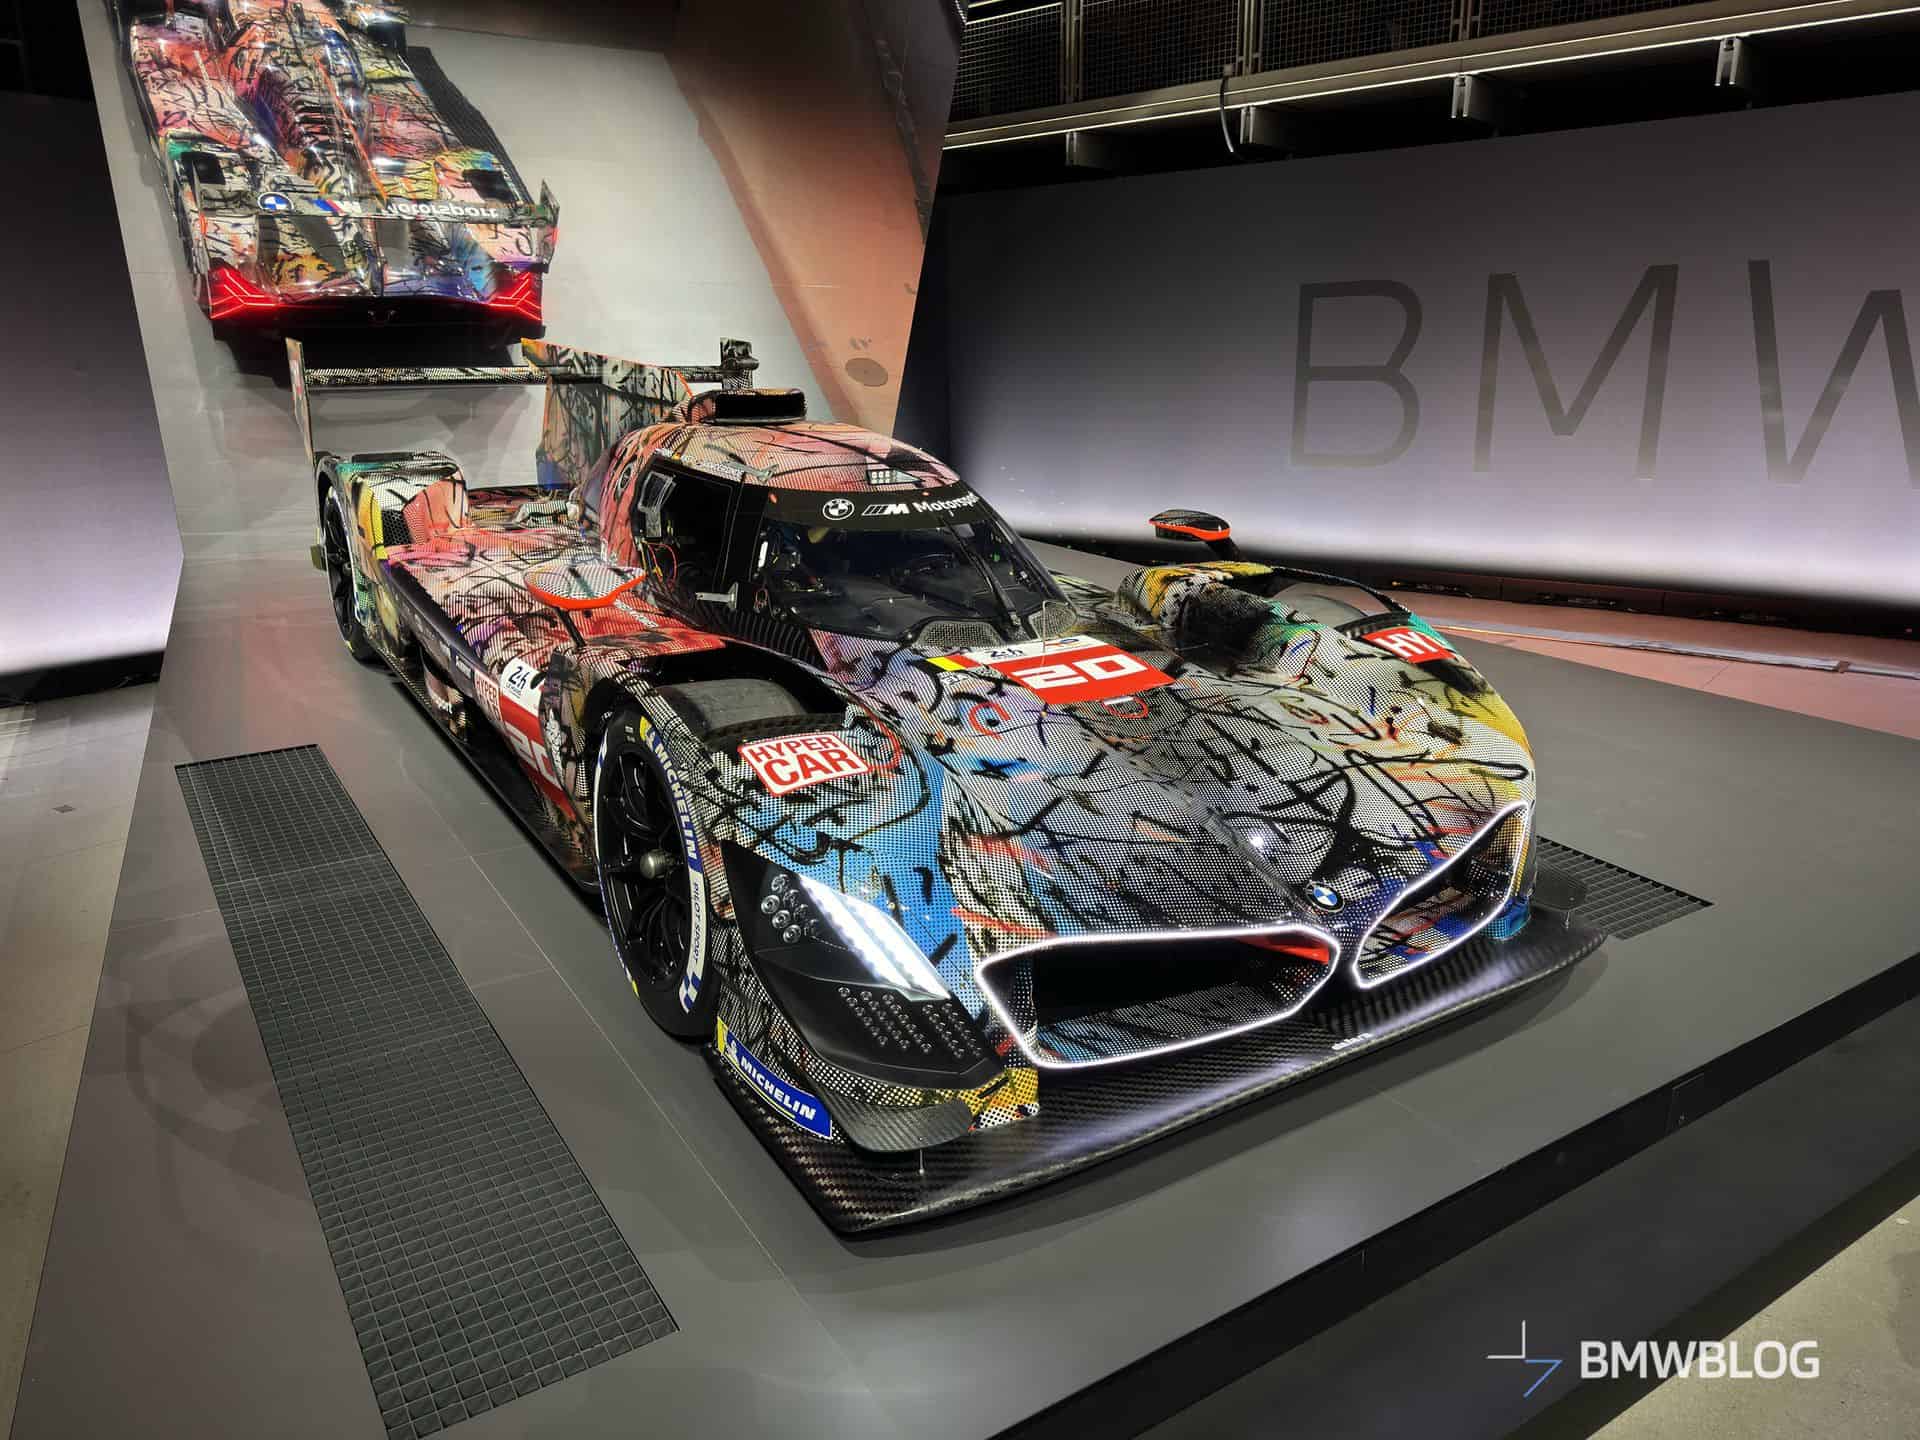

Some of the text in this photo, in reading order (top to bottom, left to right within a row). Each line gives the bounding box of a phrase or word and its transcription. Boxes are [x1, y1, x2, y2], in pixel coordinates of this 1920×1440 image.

[1290, 259, 1920, 488] BMW
[1373, 631, 1439, 657] HY
[1011, 654, 1148, 689] 20
[748, 736, 840, 763] HYPER
[763, 749, 860, 786] CAR
[655, 745, 698, 861] MICHELIN
[741, 1056, 817, 1120] MICHELIN
